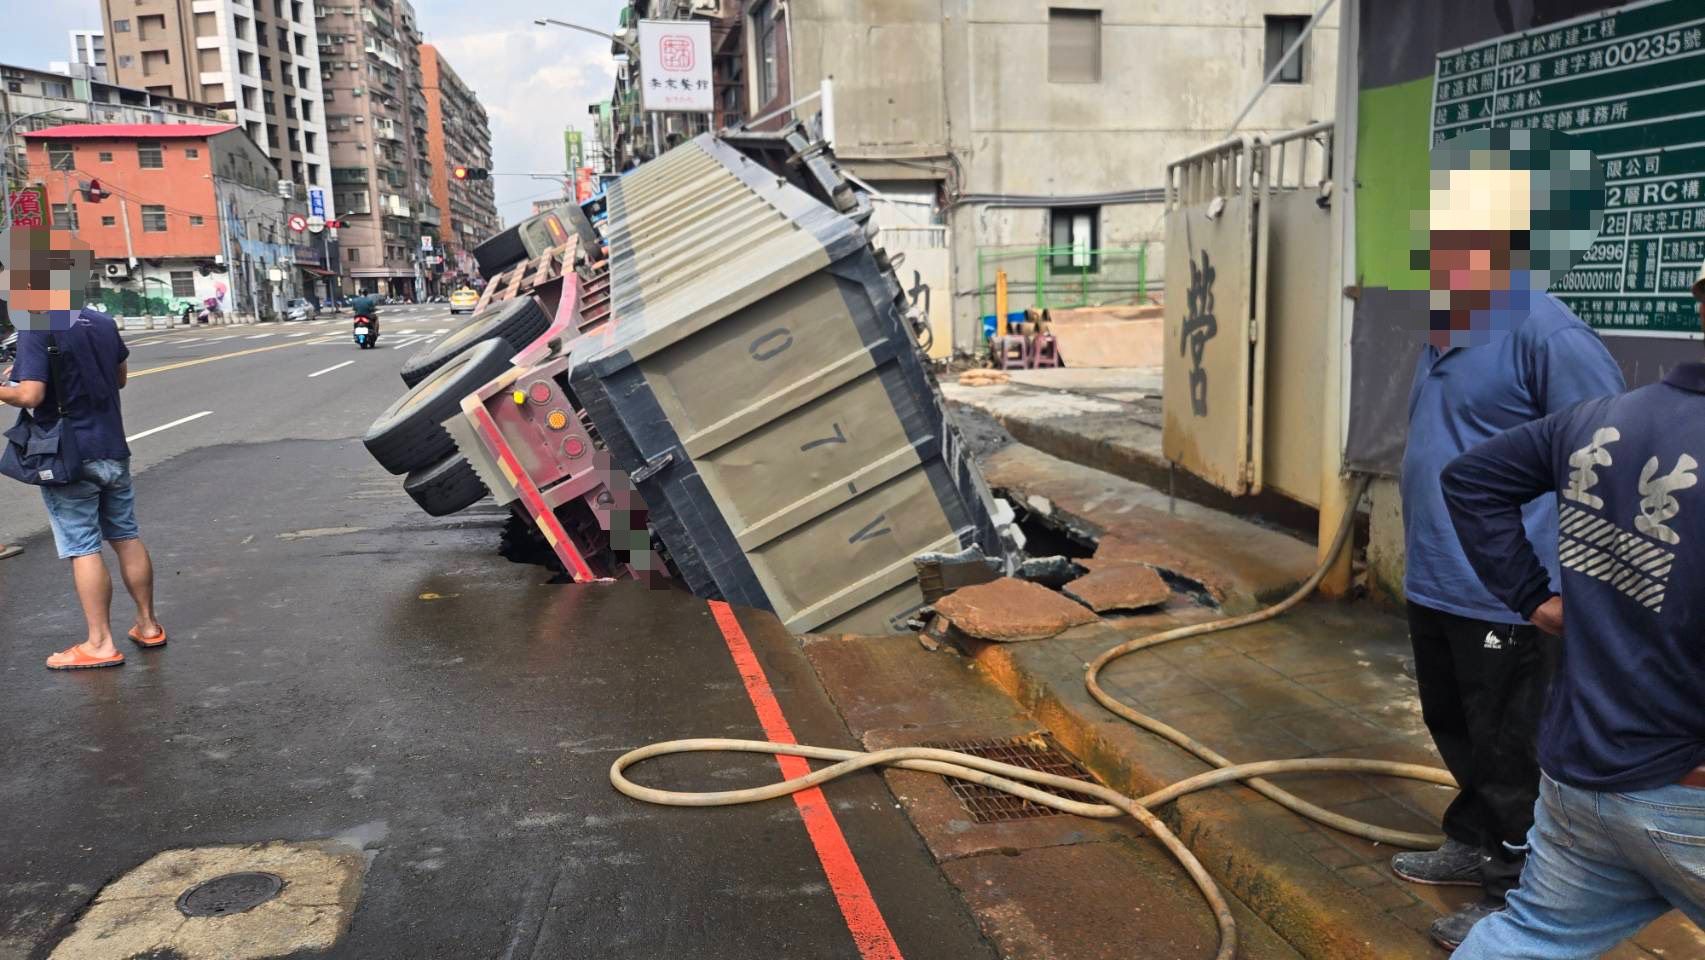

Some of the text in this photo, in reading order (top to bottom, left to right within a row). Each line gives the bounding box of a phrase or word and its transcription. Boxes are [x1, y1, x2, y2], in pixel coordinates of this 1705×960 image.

[1440, 46, 1496, 77] 工程名稱
[1553, 27, 1702, 77] 建字第00235號
[1438, 72, 1494, 101] 建造執照
[1496, 89, 1542, 114] 陳清松
[1601, 156, 1660, 178] 限公司
[1605, 180, 1700, 207] 2層RC構
